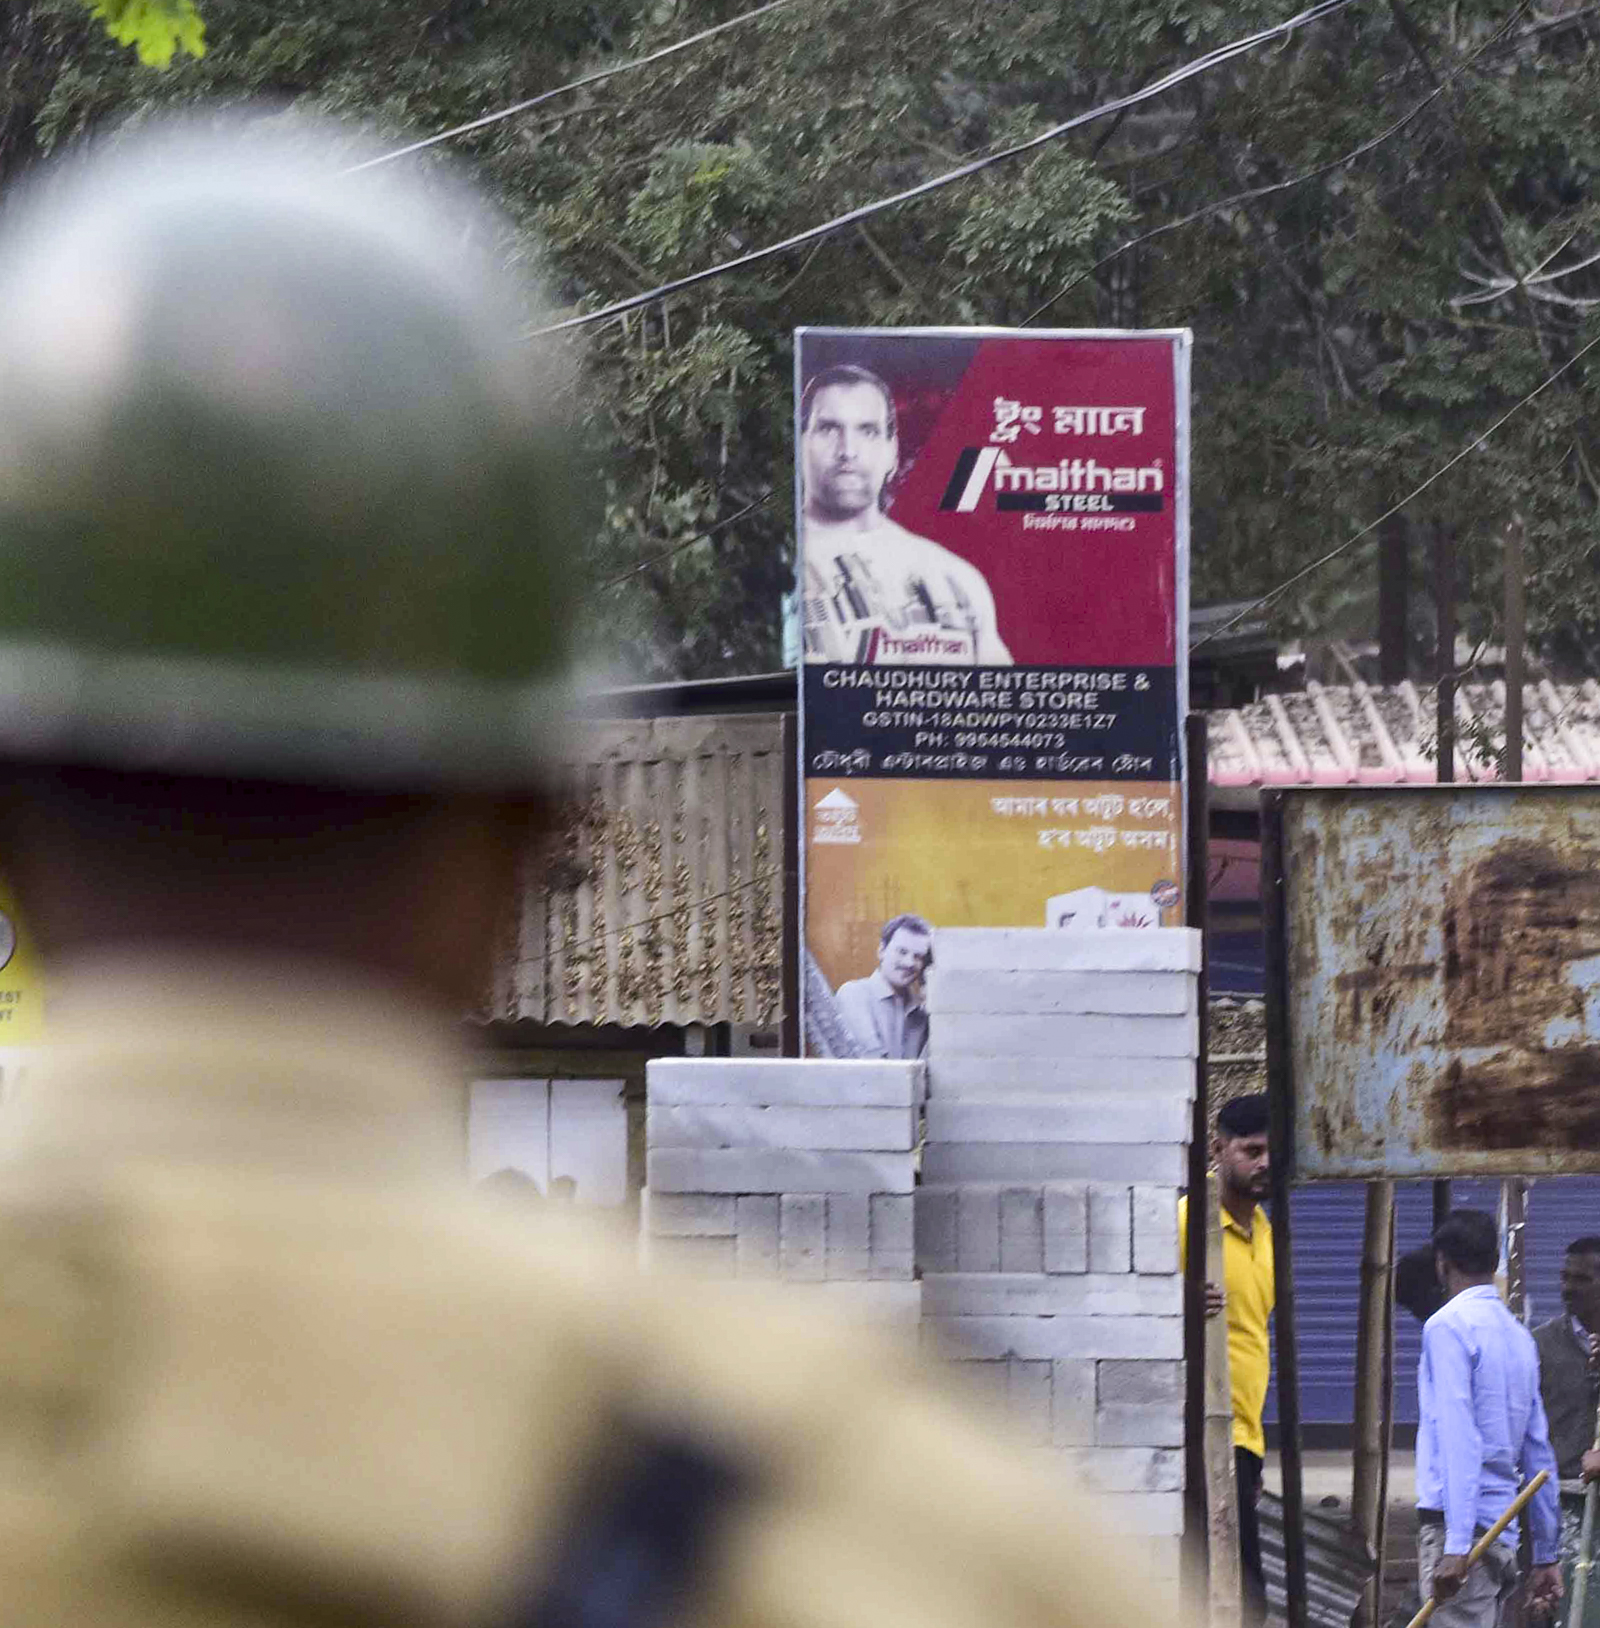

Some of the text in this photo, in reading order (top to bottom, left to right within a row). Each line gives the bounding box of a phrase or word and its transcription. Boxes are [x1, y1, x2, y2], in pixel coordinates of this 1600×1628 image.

[994, 455, 1164, 491] maithan
[1044, 494, 1115, 512] STEEL
[823, 670, 1151, 691] CHAUDHURY ENTERPRISE &
[876, 690, 1099, 710] HARDWARE STORE
[914, 732, 950, 748] PH:
